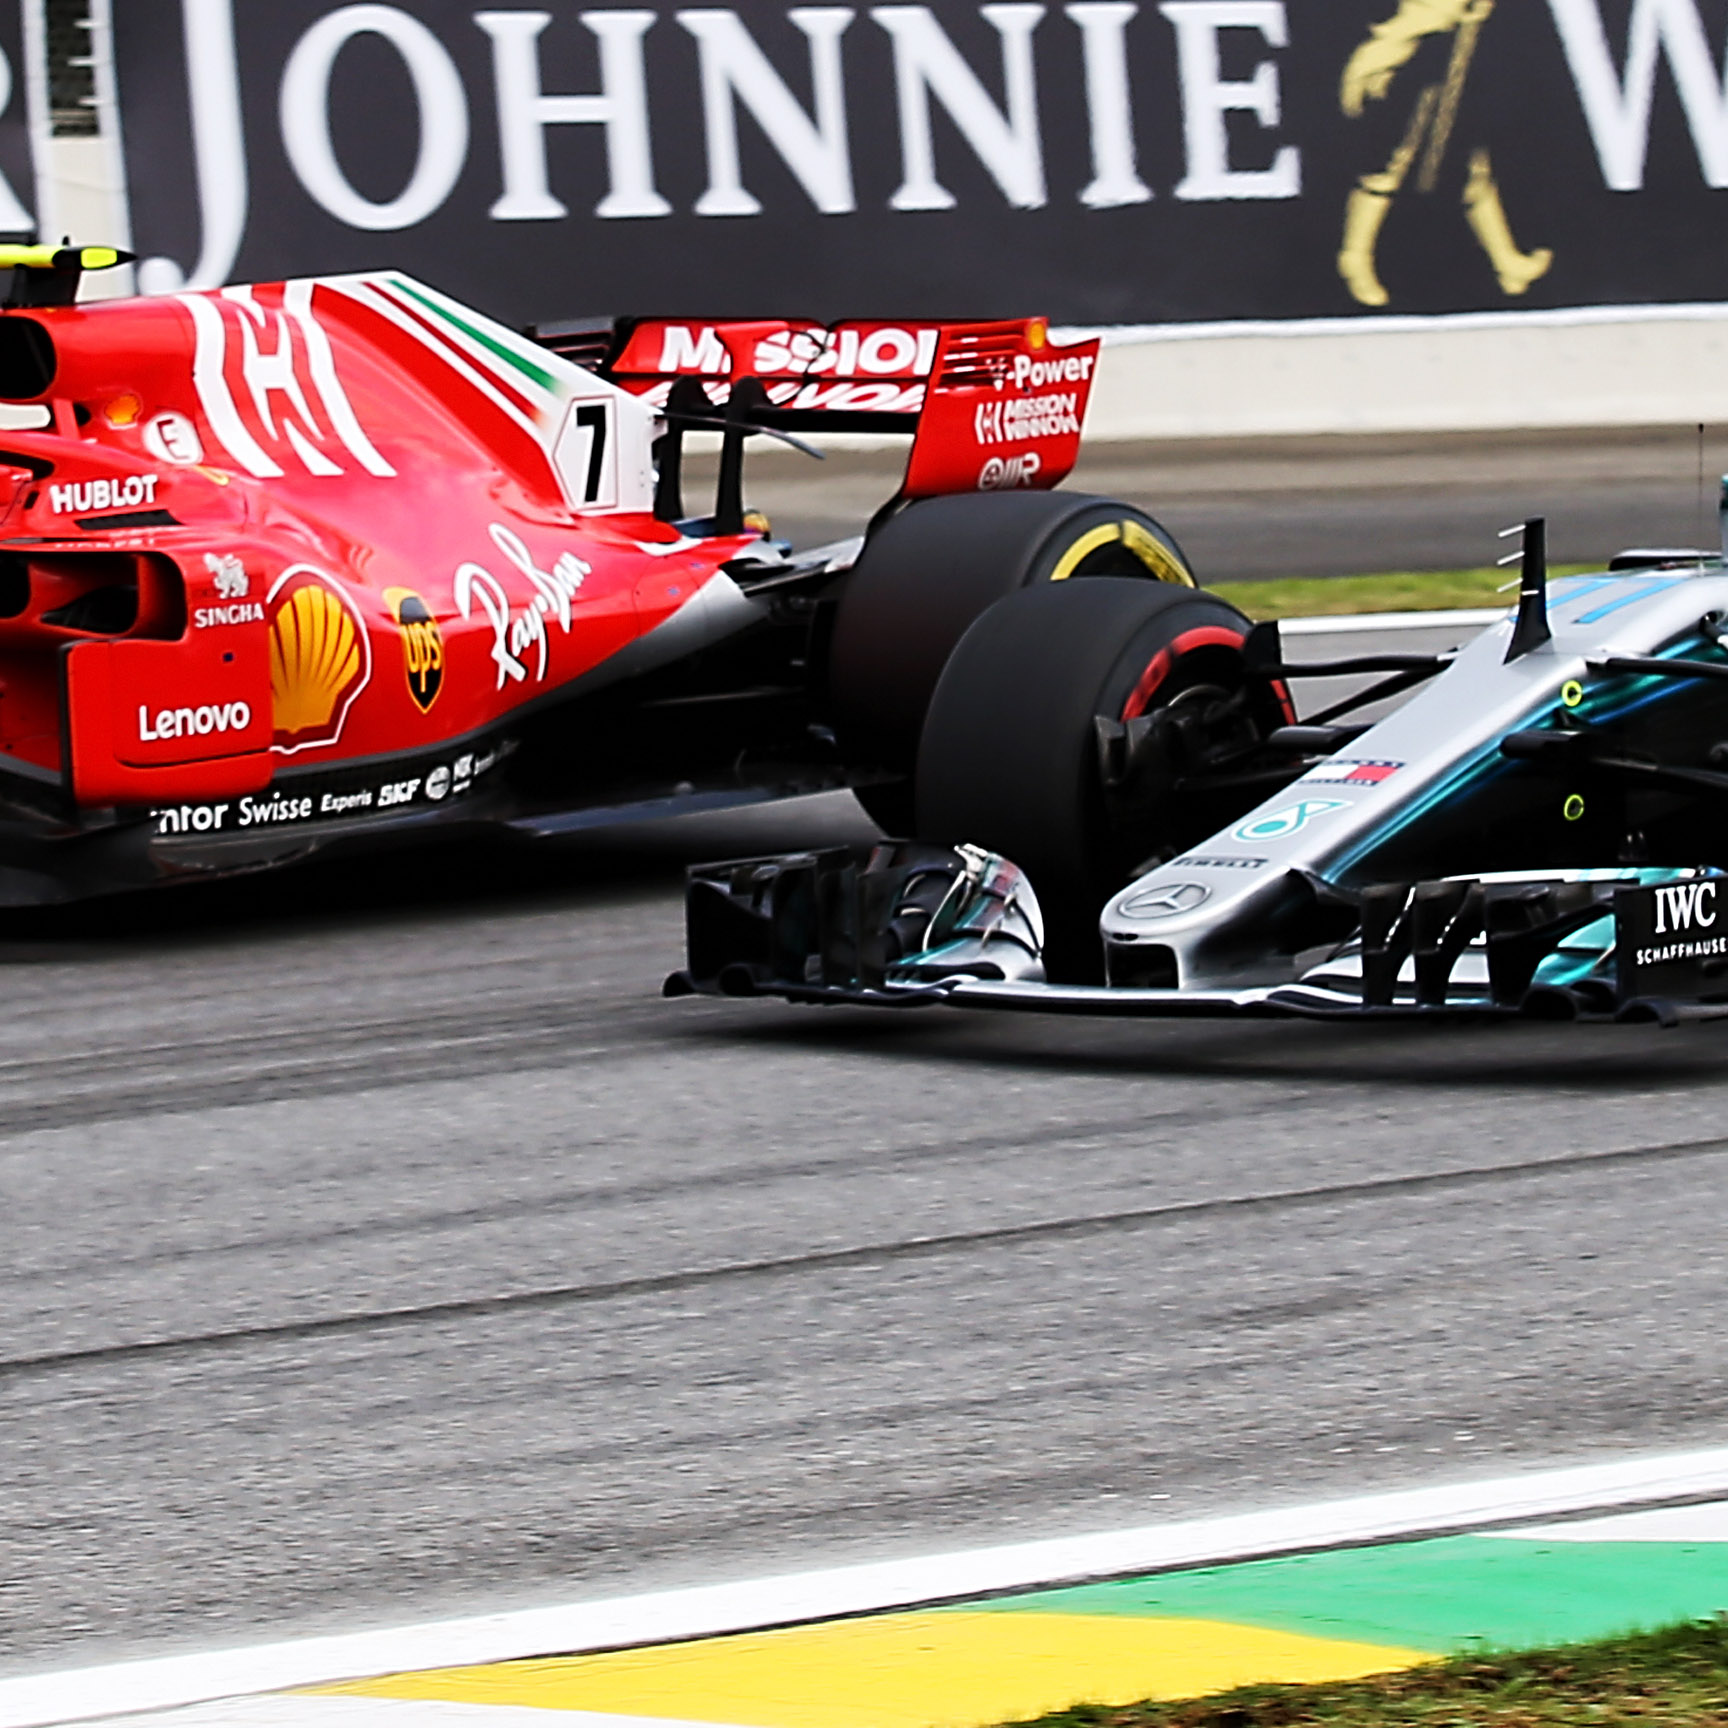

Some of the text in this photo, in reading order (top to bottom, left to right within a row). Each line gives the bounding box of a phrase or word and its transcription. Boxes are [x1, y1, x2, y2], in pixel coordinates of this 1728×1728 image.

[575, 402, 607, 503] 7
[49, 474, 159, 514] HUBLOT
[194, 602, 265, 628] SINGHA
[139, 701, 250, 741] Lenovo
[238, 791, 313, 826] Swisse
[320, 788, 373, 814] Experis
[378, 778, 421, 806] SKF
[1655, 881, 1716, 934] IWC
